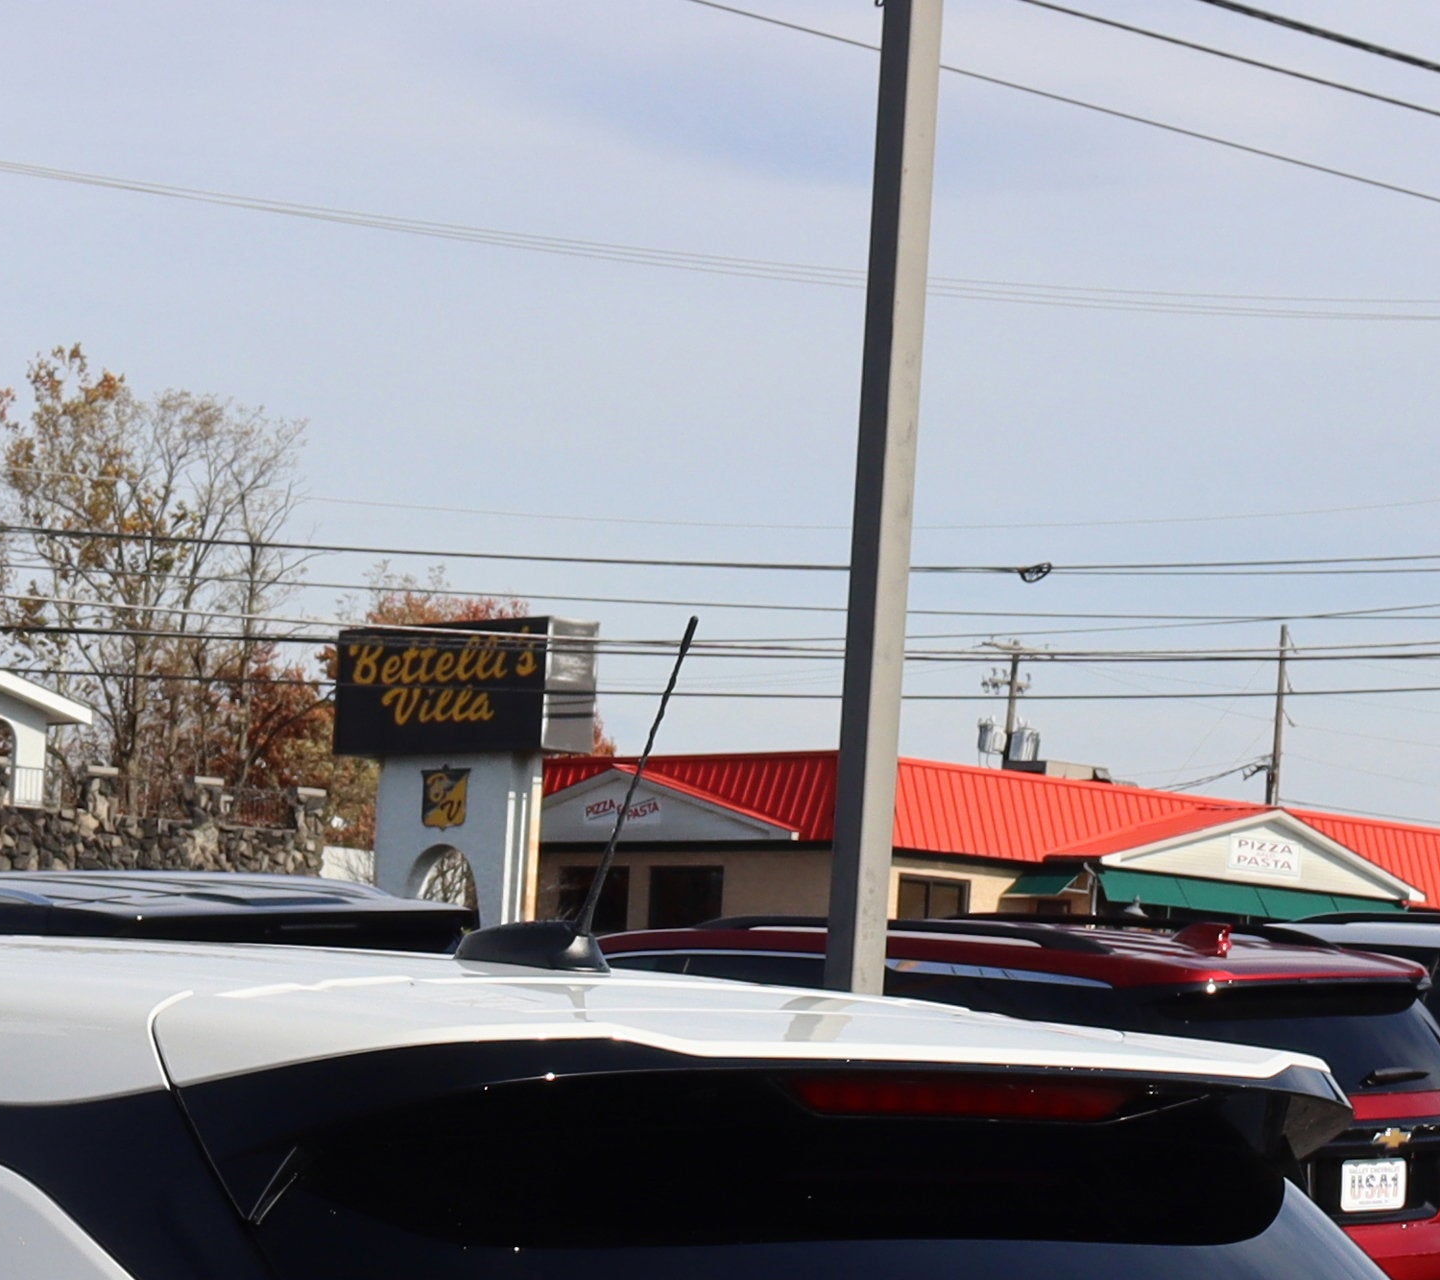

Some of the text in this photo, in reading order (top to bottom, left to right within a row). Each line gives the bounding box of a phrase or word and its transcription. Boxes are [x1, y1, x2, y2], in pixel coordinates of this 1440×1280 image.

[349, 627, 538, 684] Bettelli's
[382, 687, 495, 725] Villa
[585, 799, 616, 816] PIZZA
[627, 802, 660, 820] PASTA
[1238, 839, 1293, 854] PIZZA
[1237, 855, 1292, 870] PASTA
